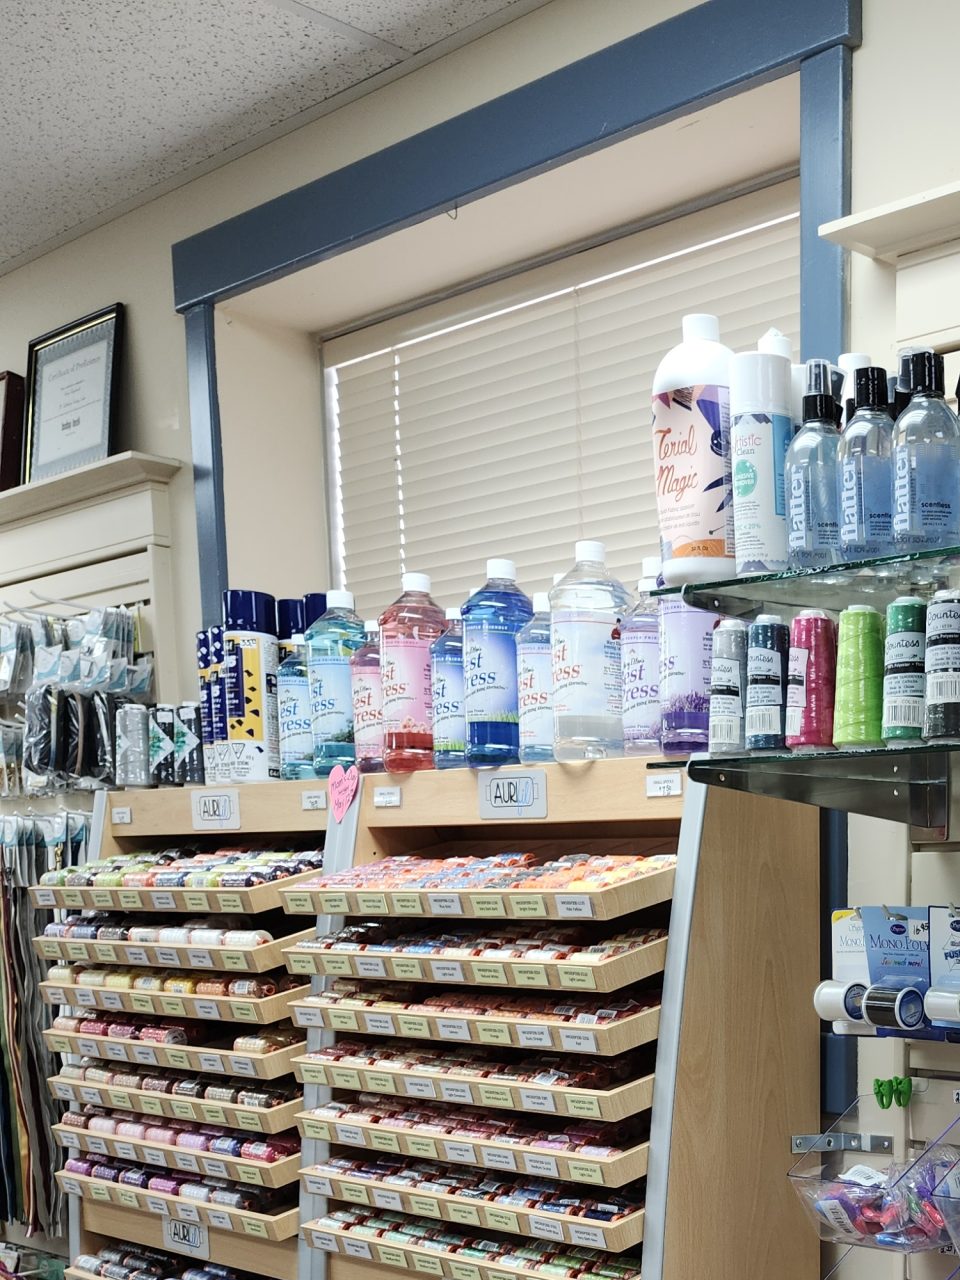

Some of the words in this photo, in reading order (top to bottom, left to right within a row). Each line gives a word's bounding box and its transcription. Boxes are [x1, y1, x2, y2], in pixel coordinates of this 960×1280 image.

[655, 424, 698, 461] Terial
[657, 465, 699, 502] Magic
[869, 512, 892, 520] scentle
[465, 672, 496, 690] ress
[553, 664, 583, 686] ress
[624, 663, 645, 684] est
[353, 692, 373, 709] est
[520, 691, 548, 709] ress
[624, 684, 659, 702] ress
[280, 702, 299, 719] est
[311, 699, 335, 715] ress
[354, 709, 383, 724] ress
[281, 719, 311, 733] ress
